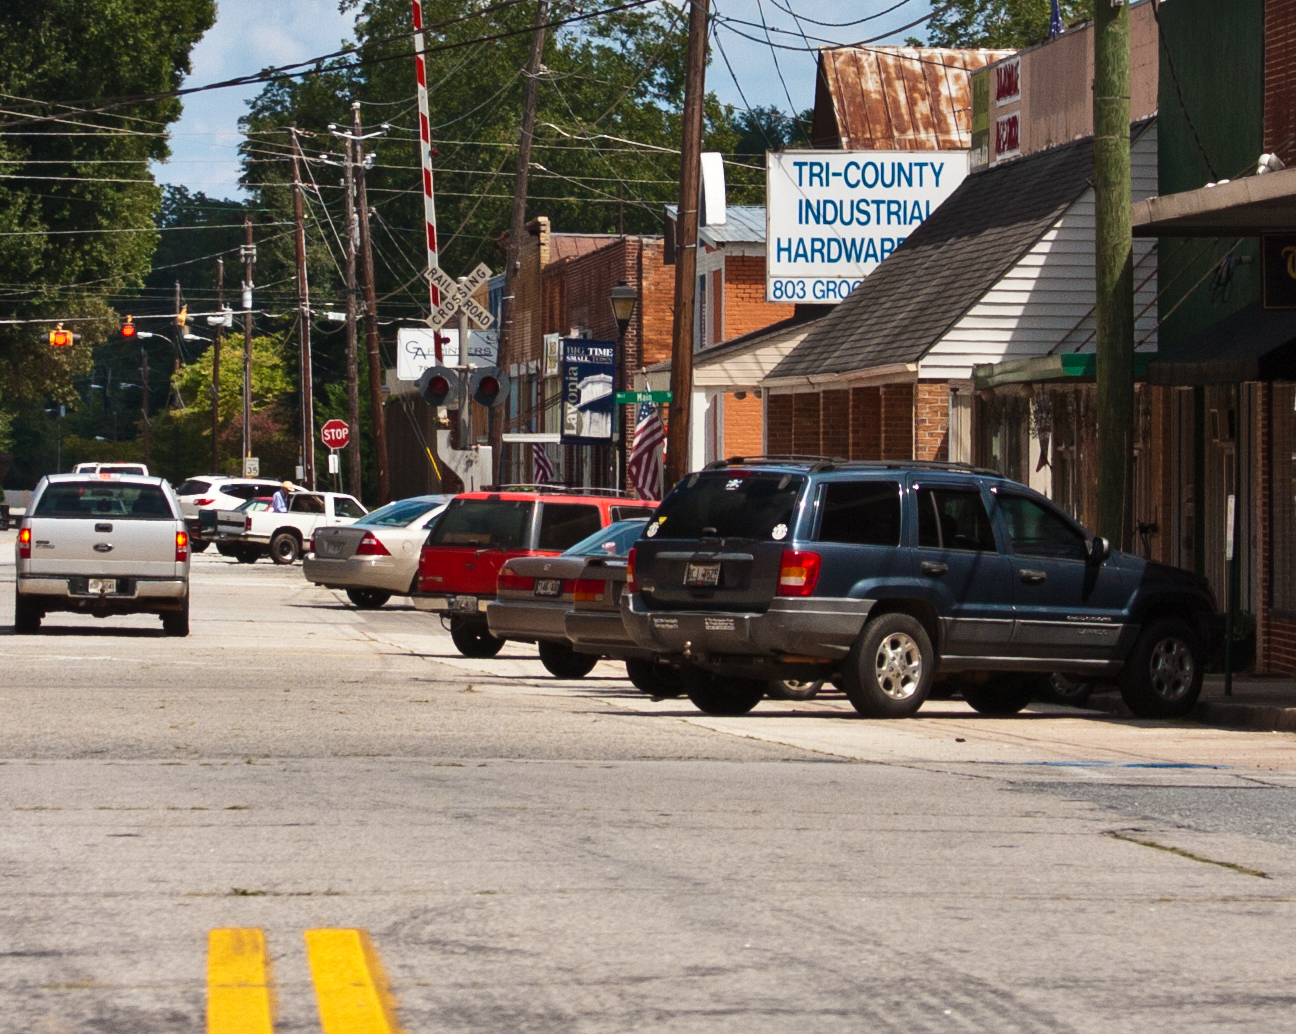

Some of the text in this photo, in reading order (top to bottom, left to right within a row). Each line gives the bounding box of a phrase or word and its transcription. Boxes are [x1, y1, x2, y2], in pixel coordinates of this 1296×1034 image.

[792, 160, 945, 189] TRI-COUNTY
[776, 237, 907, 263] HARDWAR
[427, 267, 491, 326] RAIL ROAD
[431, 268, 486, 325] CROSSING
[772, 279, 806, 300] 803
[587, 347, 614, 357] TIME
[564, 366, 579, 435] Lavonia
[636, 393, 653, 402] Main
[323, 427, 349, 441] STOP
[247, 466, 258, 475] 35
